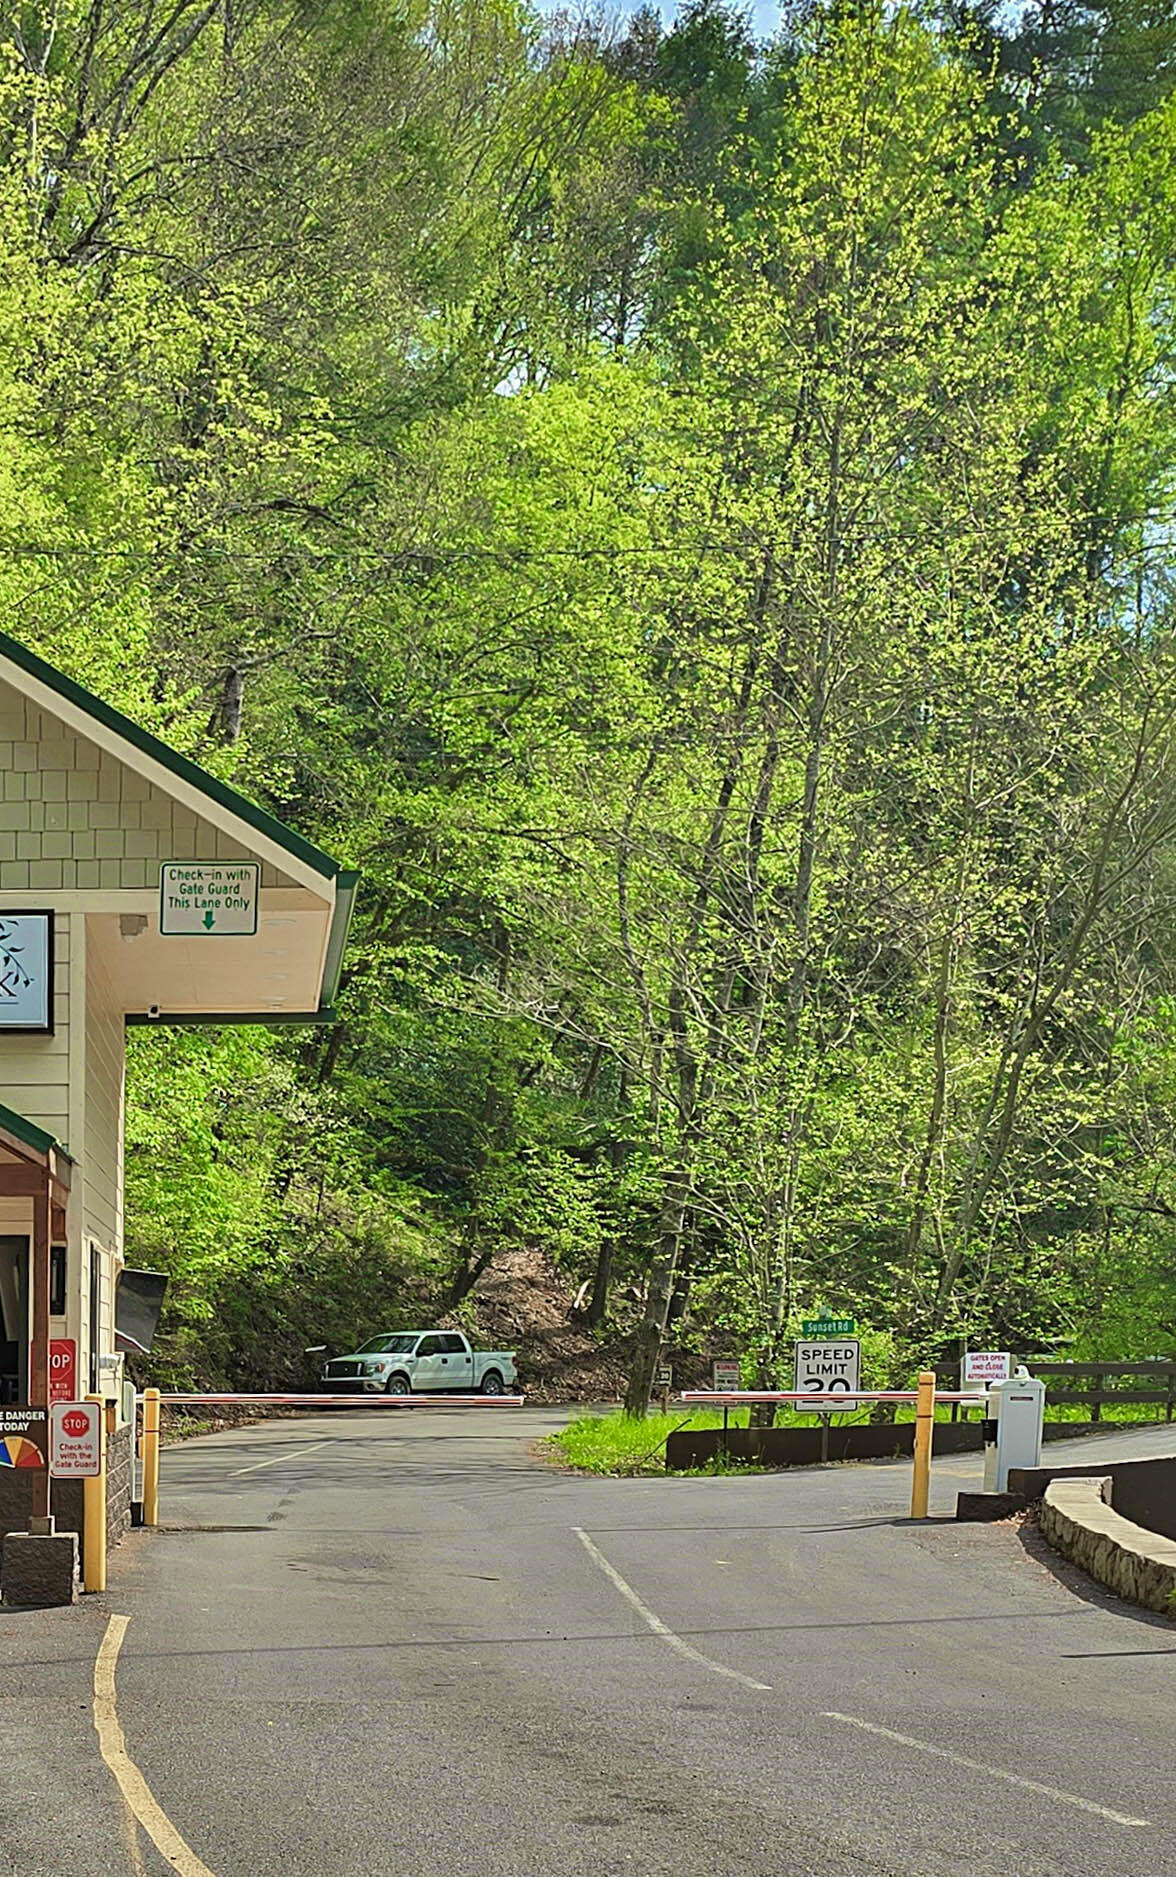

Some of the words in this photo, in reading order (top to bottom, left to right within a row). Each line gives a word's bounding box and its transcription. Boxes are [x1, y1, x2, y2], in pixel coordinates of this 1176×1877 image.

[169, 868, 222, 881] Check-in
[226, 868, 251, 880] with
[179, 882, 204, 895] Gate
[207, 882, 240, 895] Guard
[168, 896, 190, 909] This
[194, 897, 221, 909] Lane
[224, 896, 250, 912] Only
[807, 1321, 837, 1333] Sunset
[838, 1320, 849, 1332] Rd
[801, 1349, 855, 1361] SPEED
[806, 1363, 849, 1375] LIMIT
[967, 1372, 1007, 1380] AUTOMATICALLY
[5, 1411, 46, 1421] DANGER
[64, 1418, 88, 1430] STOP
[59, 1442, 93, 1451] Check-in
[55, 1460, 73, 1468] Gate
[74, 1460, 97, 1468] Guard
